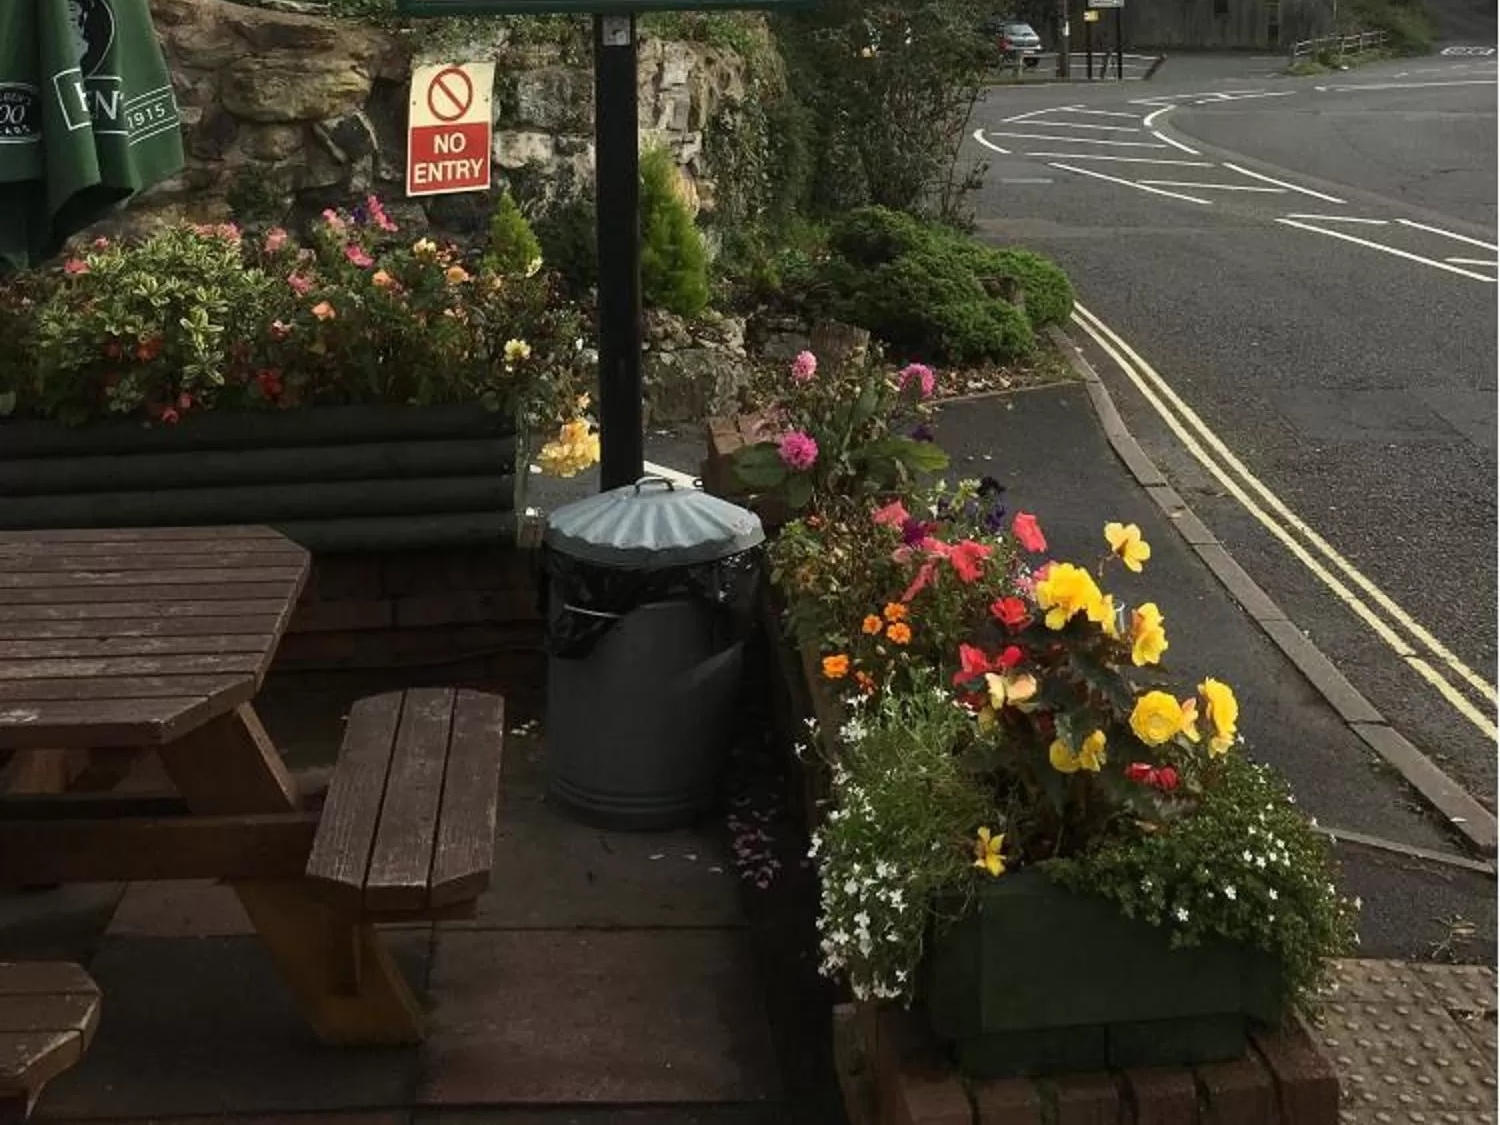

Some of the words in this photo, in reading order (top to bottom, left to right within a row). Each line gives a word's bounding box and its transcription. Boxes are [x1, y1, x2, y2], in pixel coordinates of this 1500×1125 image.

[127, 102, 166, 130] 1915
[433, 132, 467, 154] NO
[413, 158, 484, 185] ENTRY
